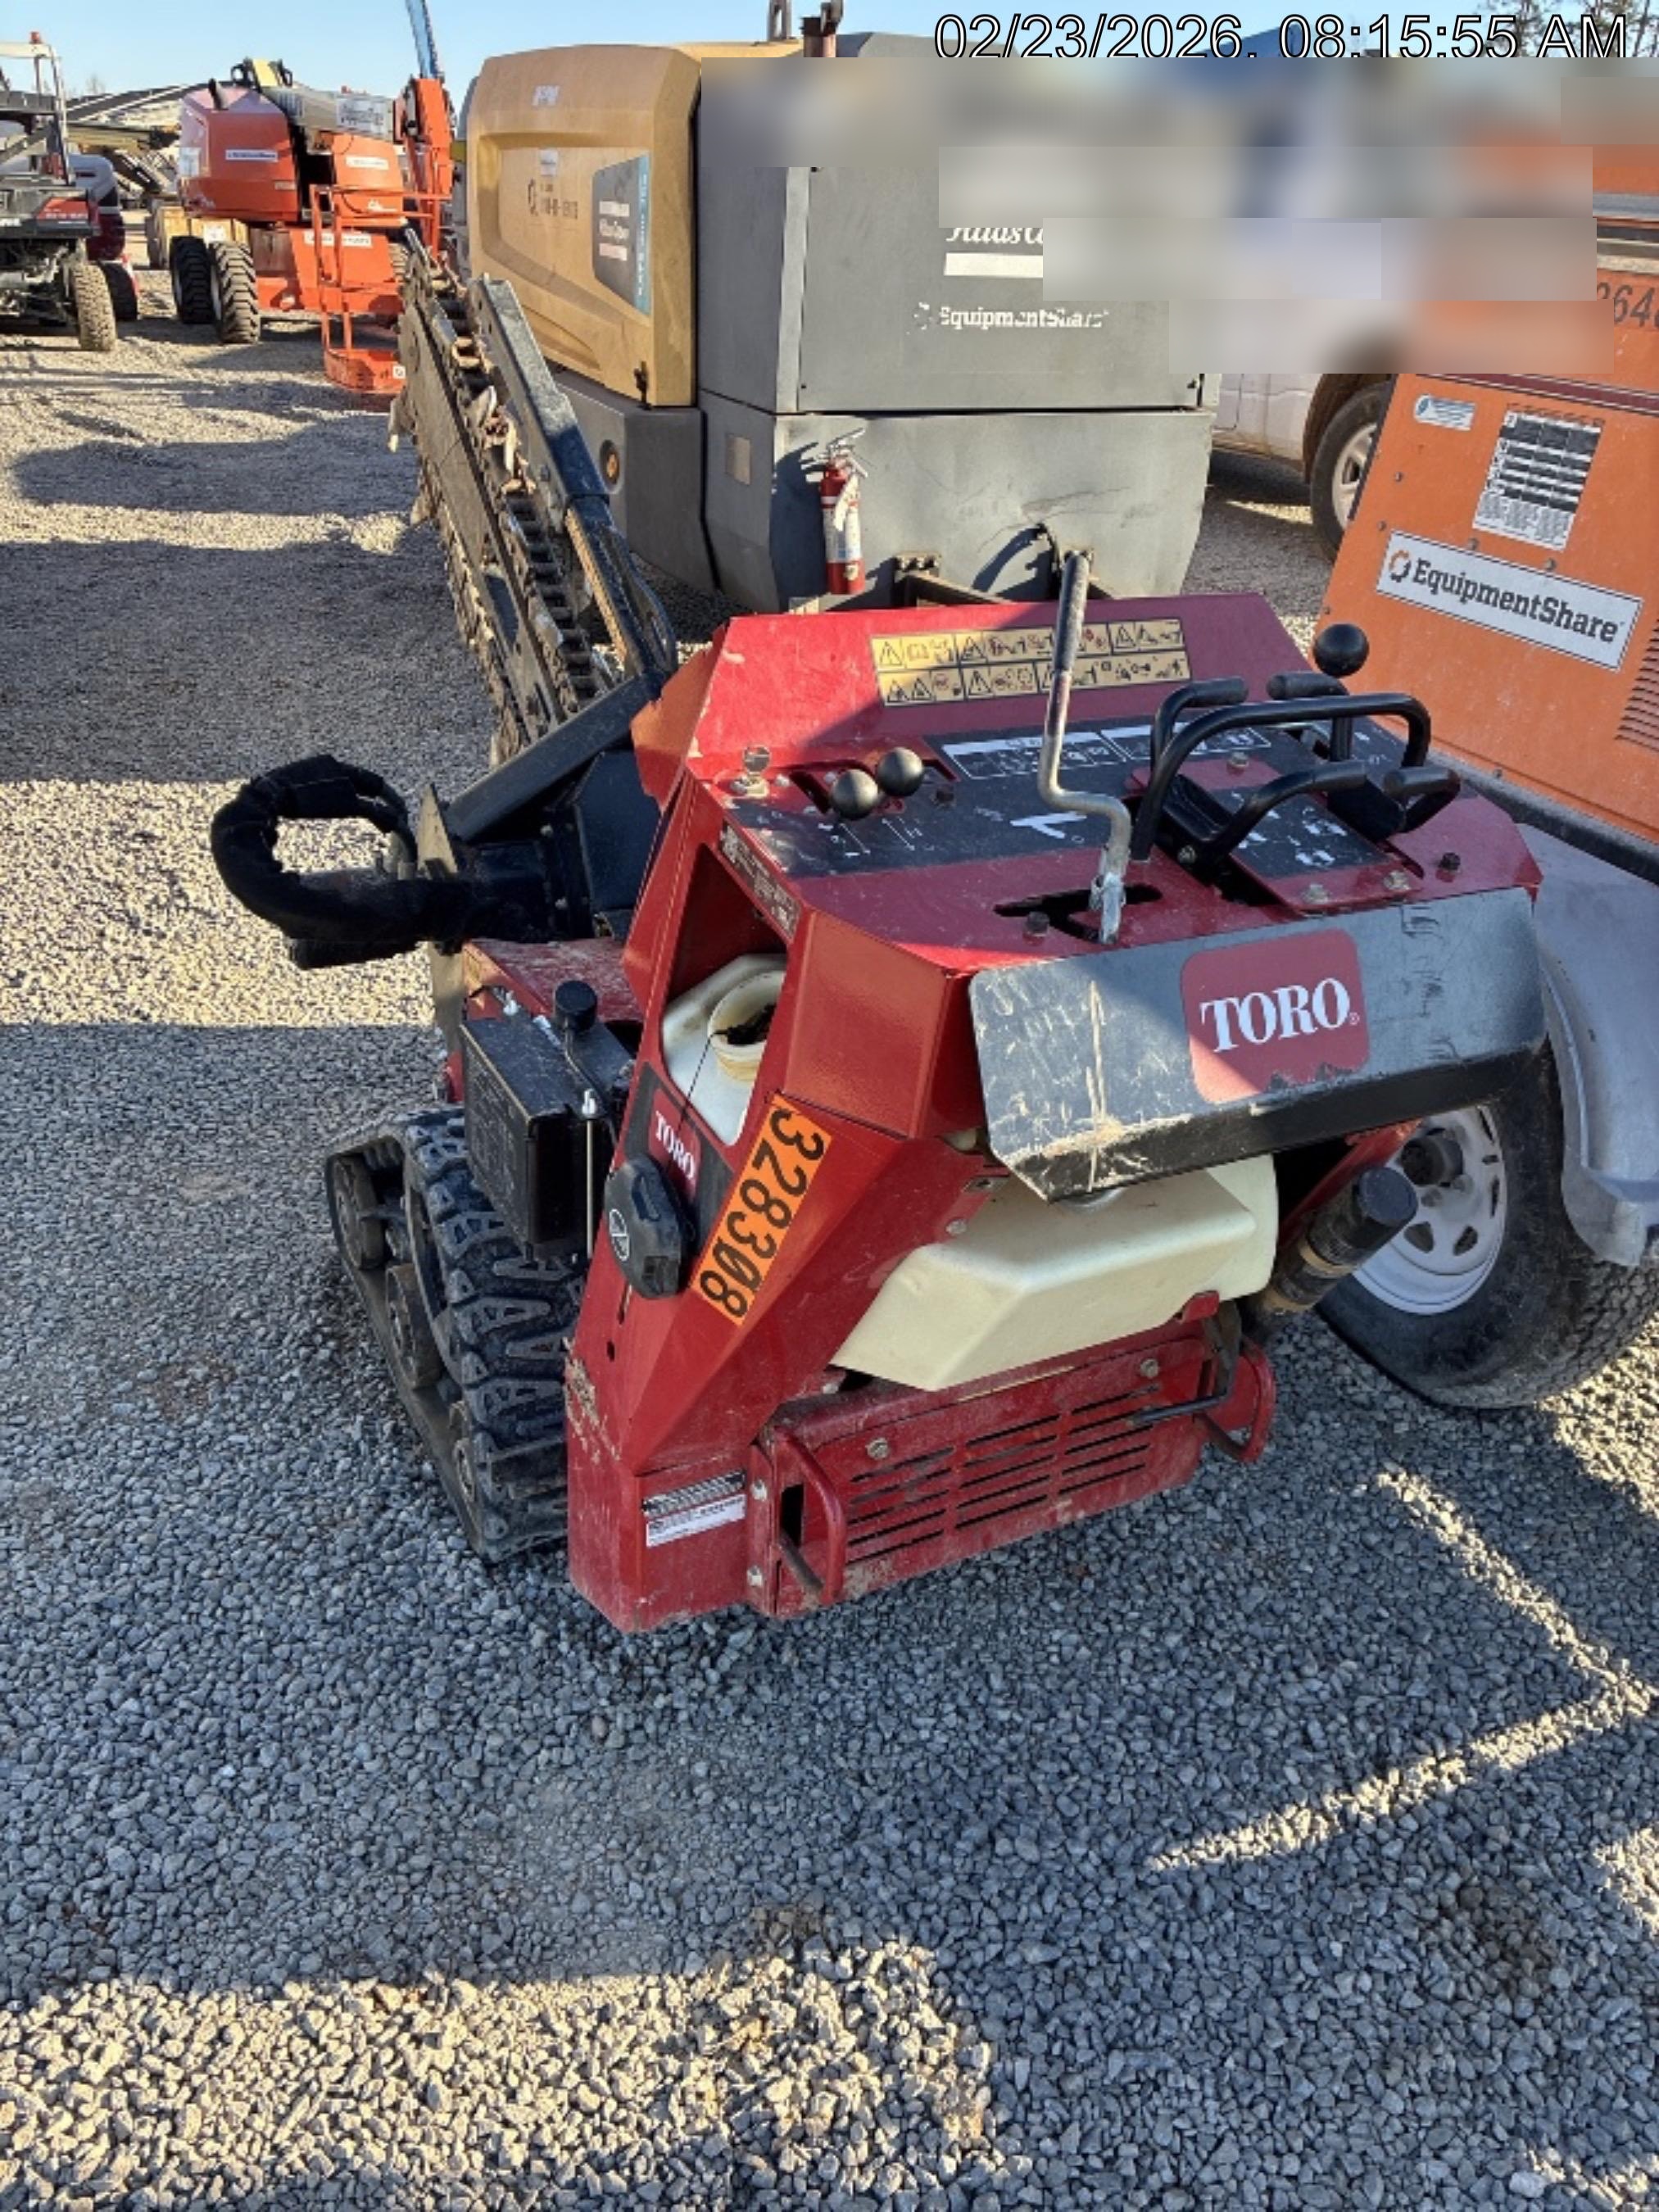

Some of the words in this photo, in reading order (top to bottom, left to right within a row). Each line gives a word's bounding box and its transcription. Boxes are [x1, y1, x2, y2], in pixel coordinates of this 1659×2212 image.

[1597, 282, 1659, 329] 64
[1412, 558, 1620, 643] EquipmentShare
[1200, 977, 1351, 1053] TORO
[655, 1110, 696, 1181] TORO
[700, 1108, 824, 1318] 328308
